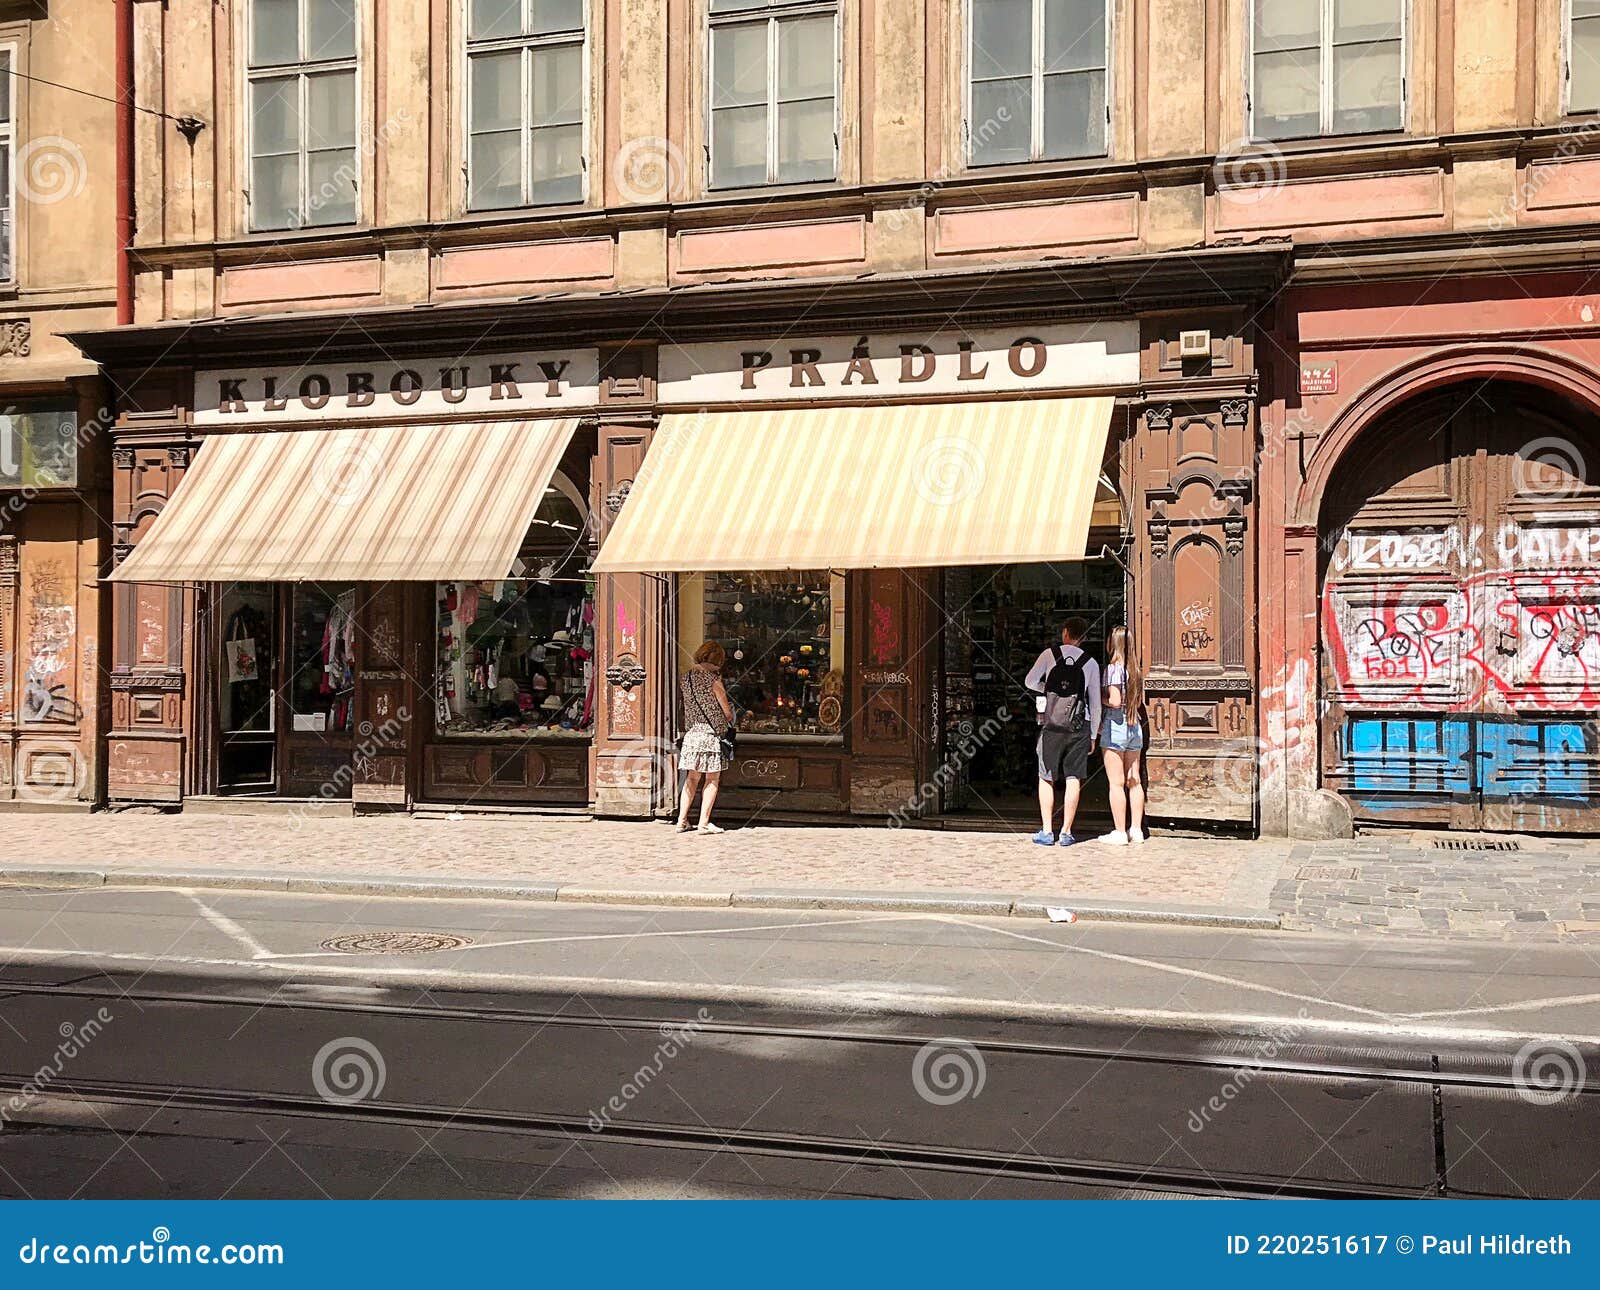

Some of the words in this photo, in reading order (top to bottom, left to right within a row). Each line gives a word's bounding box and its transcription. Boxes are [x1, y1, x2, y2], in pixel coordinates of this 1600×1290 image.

[739, 336, 1048, 389] PRÁDLO
[1303, 368, 1332, 378] 442
[218, 360, 571, 413] KLOBOUKY
[1363, 656, 1417, 679] 501
